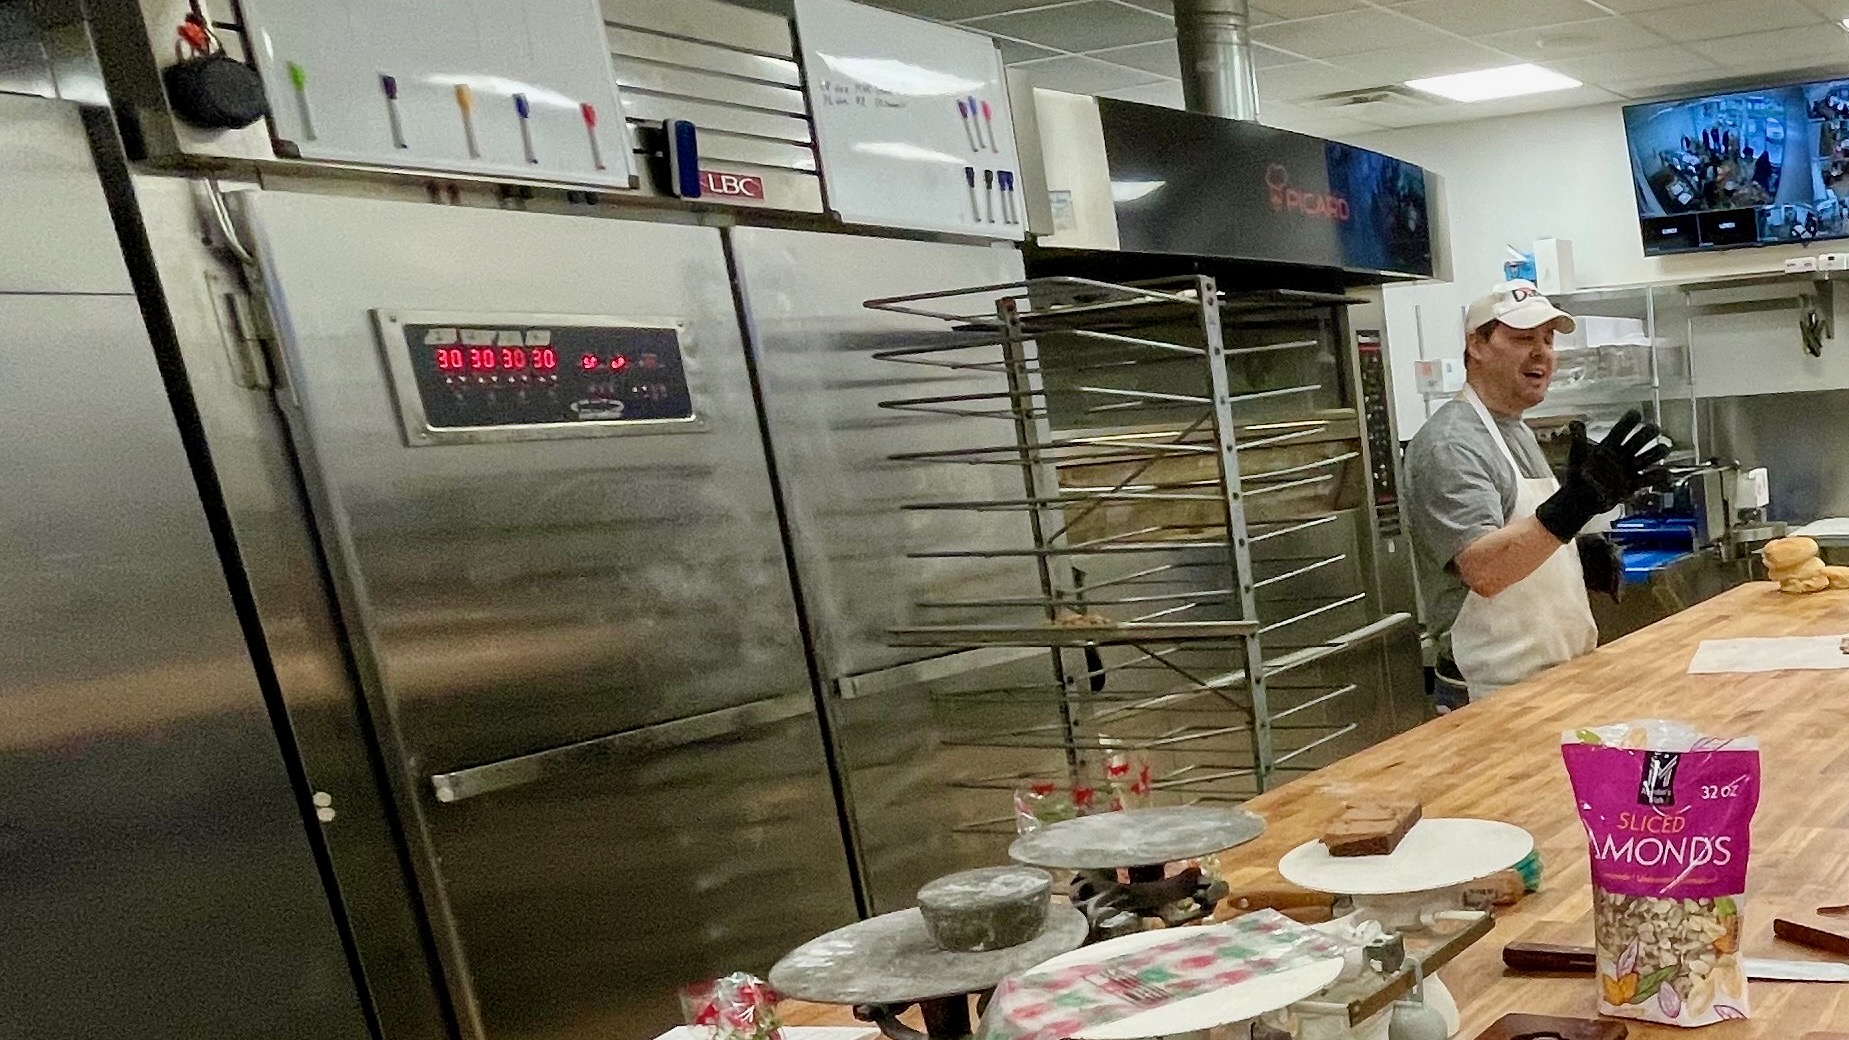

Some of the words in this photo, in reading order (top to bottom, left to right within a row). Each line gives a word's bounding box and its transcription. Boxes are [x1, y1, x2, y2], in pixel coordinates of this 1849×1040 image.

[708, 173, 756, 197] LBC
[437, 349, 463, 369] 30
[470, 349, 496, 369] 30
[502, 349, 527, 369] 30
[532, 349, 557, 369] 30
[1701, 785, 1718, 800] 32
[1616, 811, 1686, 834] SLICED
